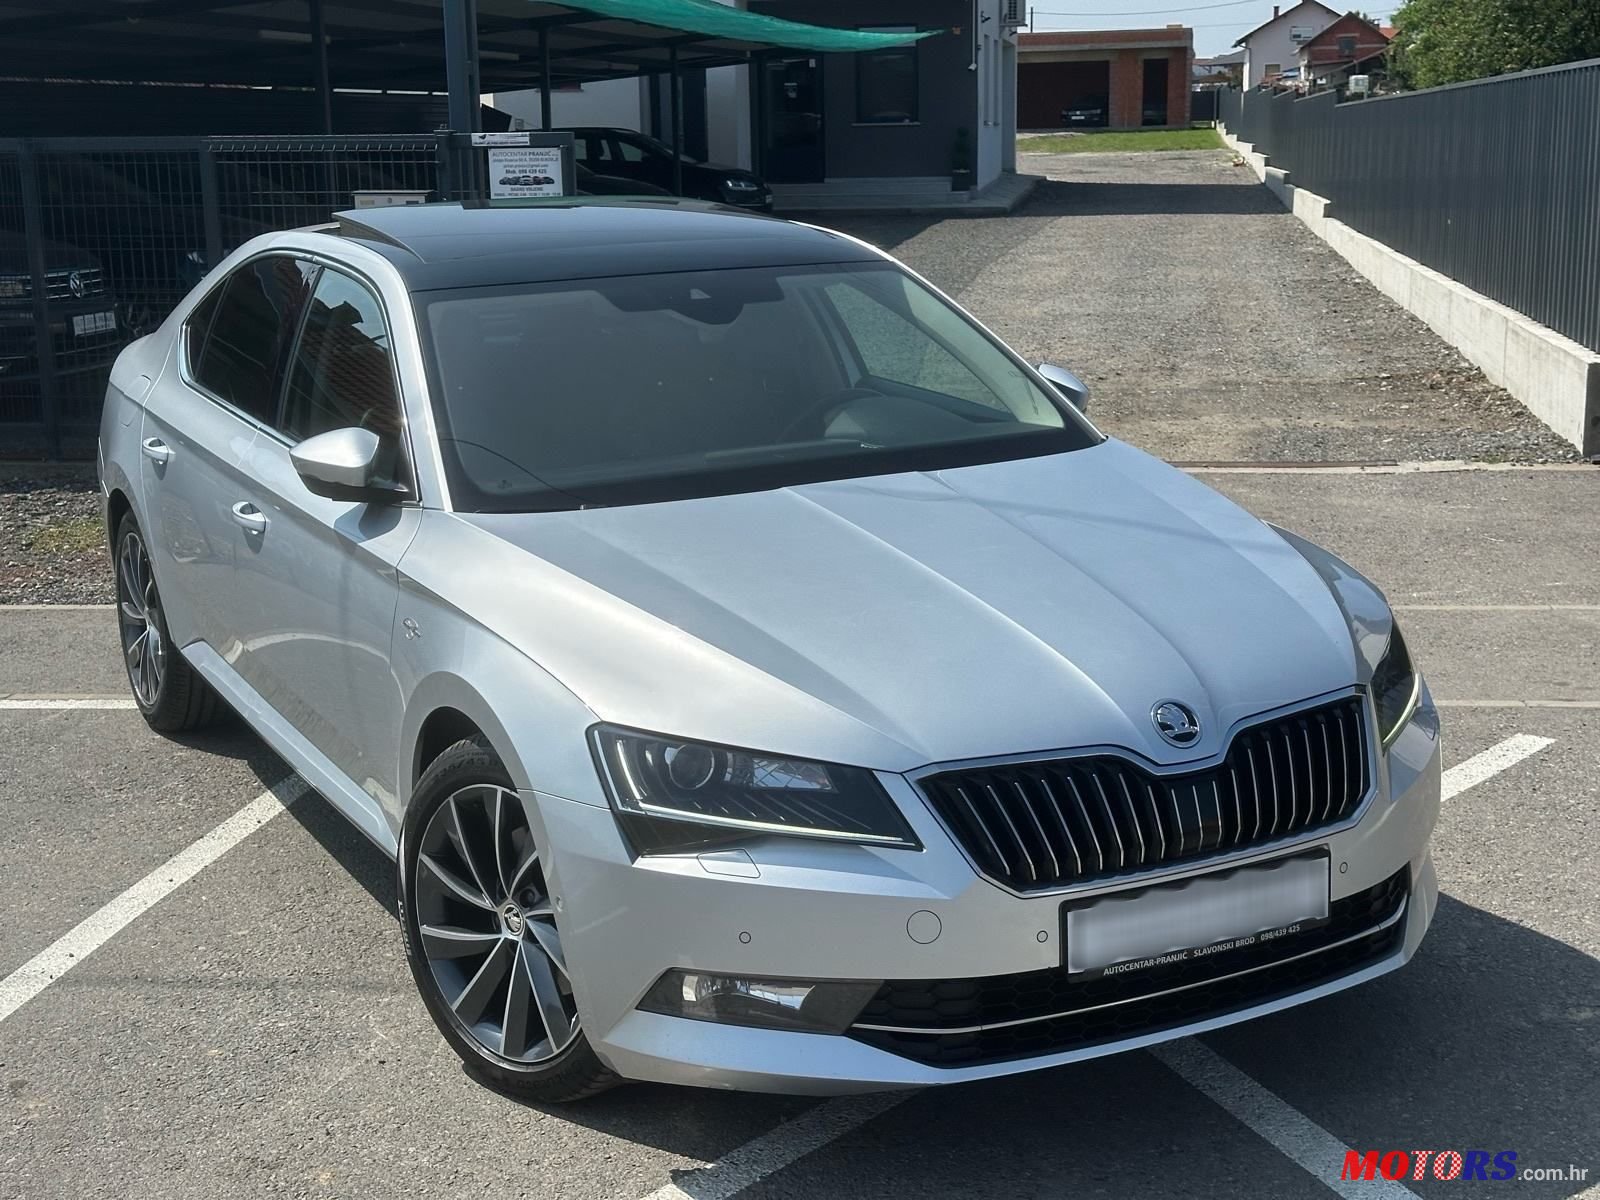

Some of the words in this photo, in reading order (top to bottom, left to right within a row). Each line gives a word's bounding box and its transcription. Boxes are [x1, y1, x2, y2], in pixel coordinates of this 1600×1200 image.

[1103, 951, 1188, 976] AUTOCENTAR-PRANJIĆ
[1193, 942, 1234, 957] SLAVONSKI
[1235, 935, 1255, 949] BROD
[1260, 927, 1287, 942] 098/439
[1287, 924, 1301, 935] 425
